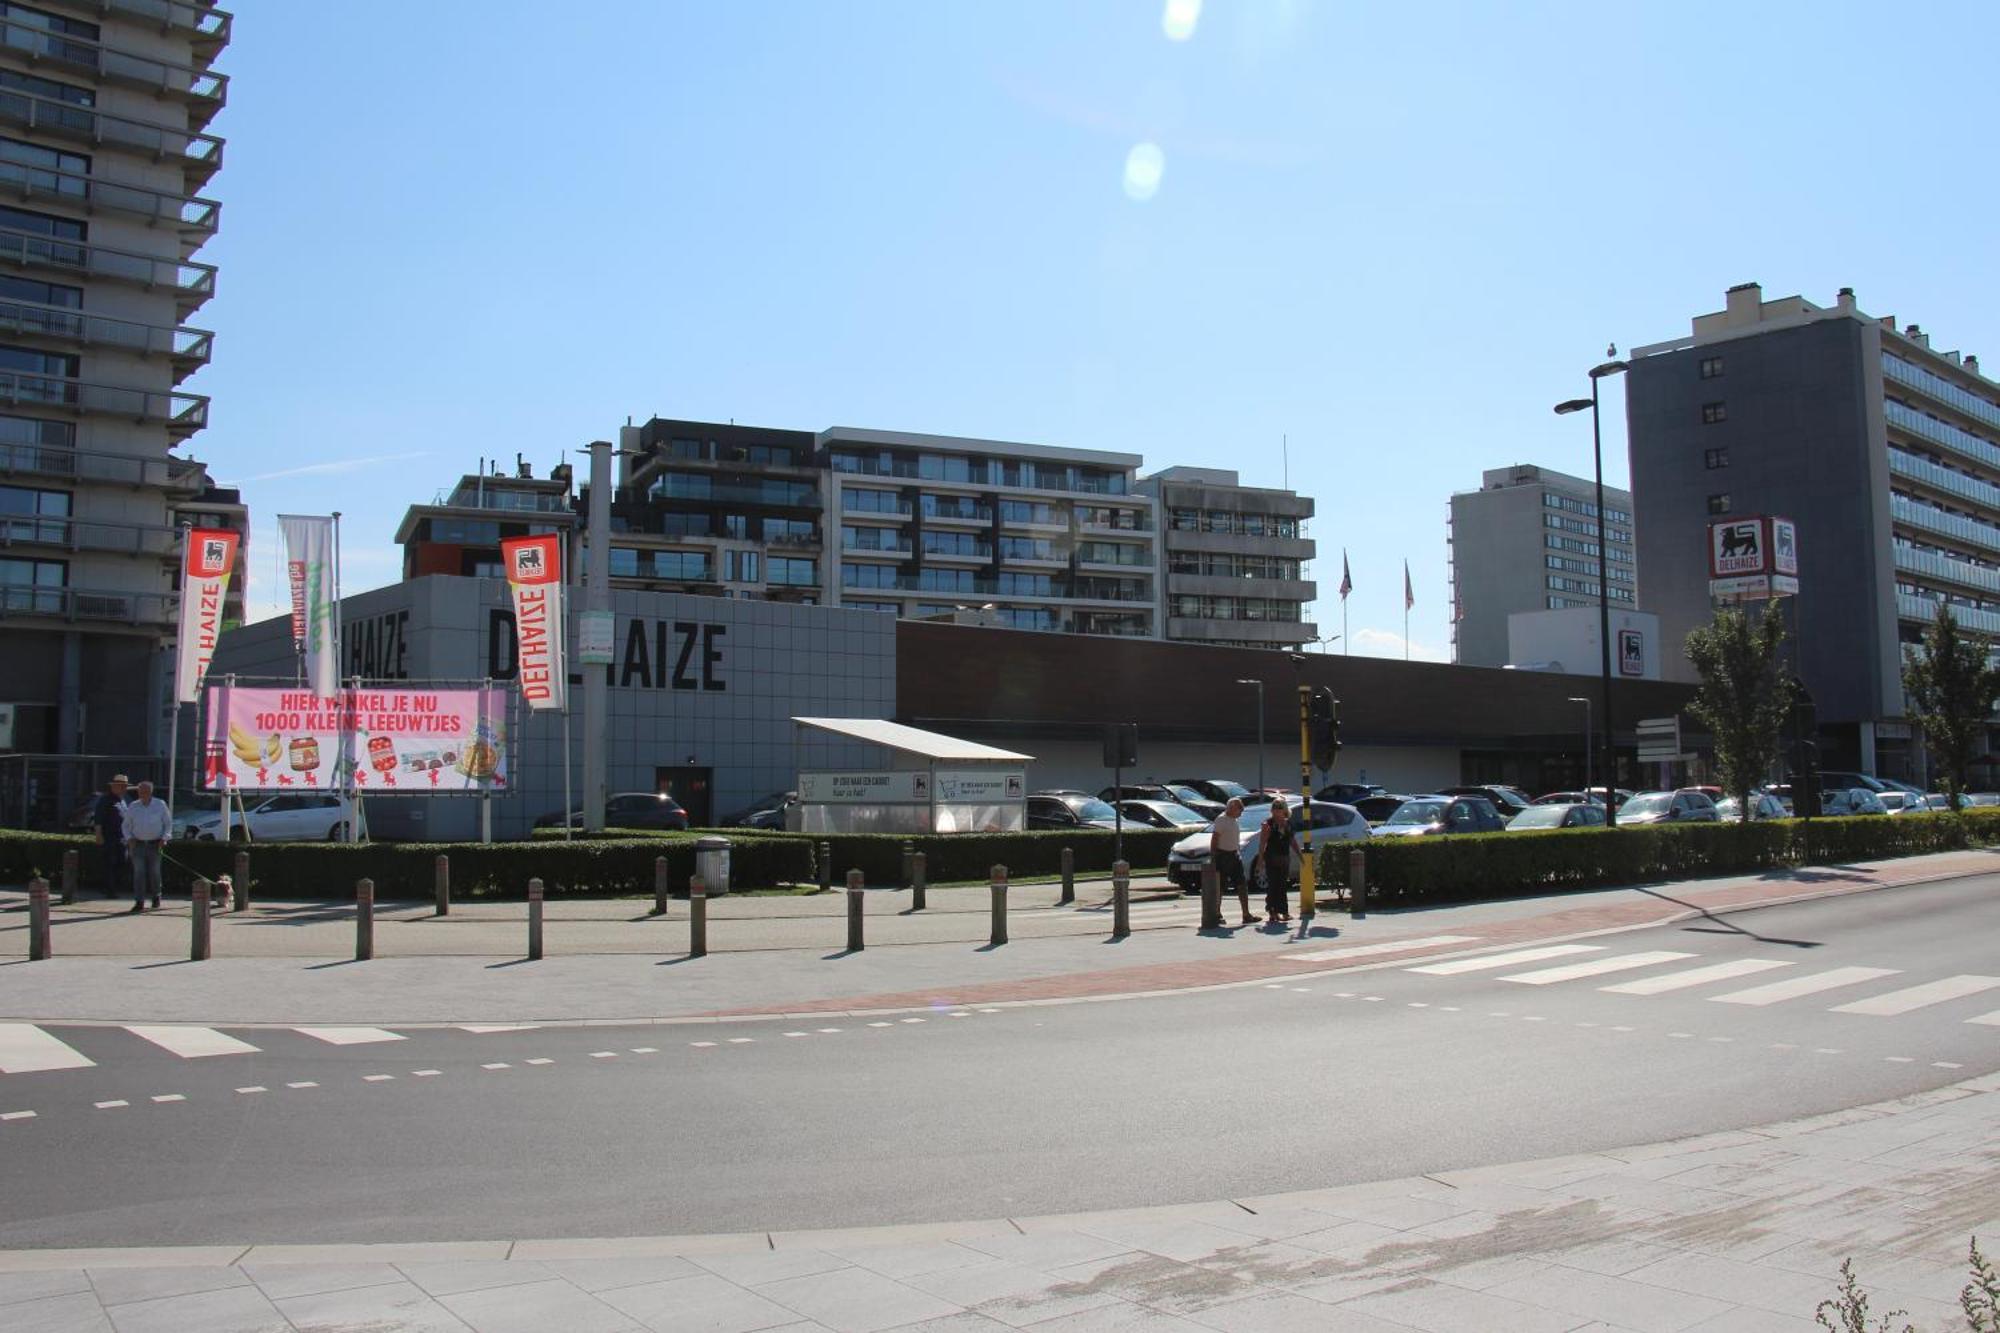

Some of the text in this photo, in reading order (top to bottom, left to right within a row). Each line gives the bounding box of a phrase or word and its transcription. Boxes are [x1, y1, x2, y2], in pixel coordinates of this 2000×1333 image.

[1719, 554, 1759, 571] DELHAIZE
[196, 583, 219, 678] LHAIZE
[489, 609, 726, 691] DAIZE
[281, 693, 437, 712] HIER WINKEL JE NU
[256, 713, 300, 730] 1000
[368, 714, 461, 732] LEEUWTJES
